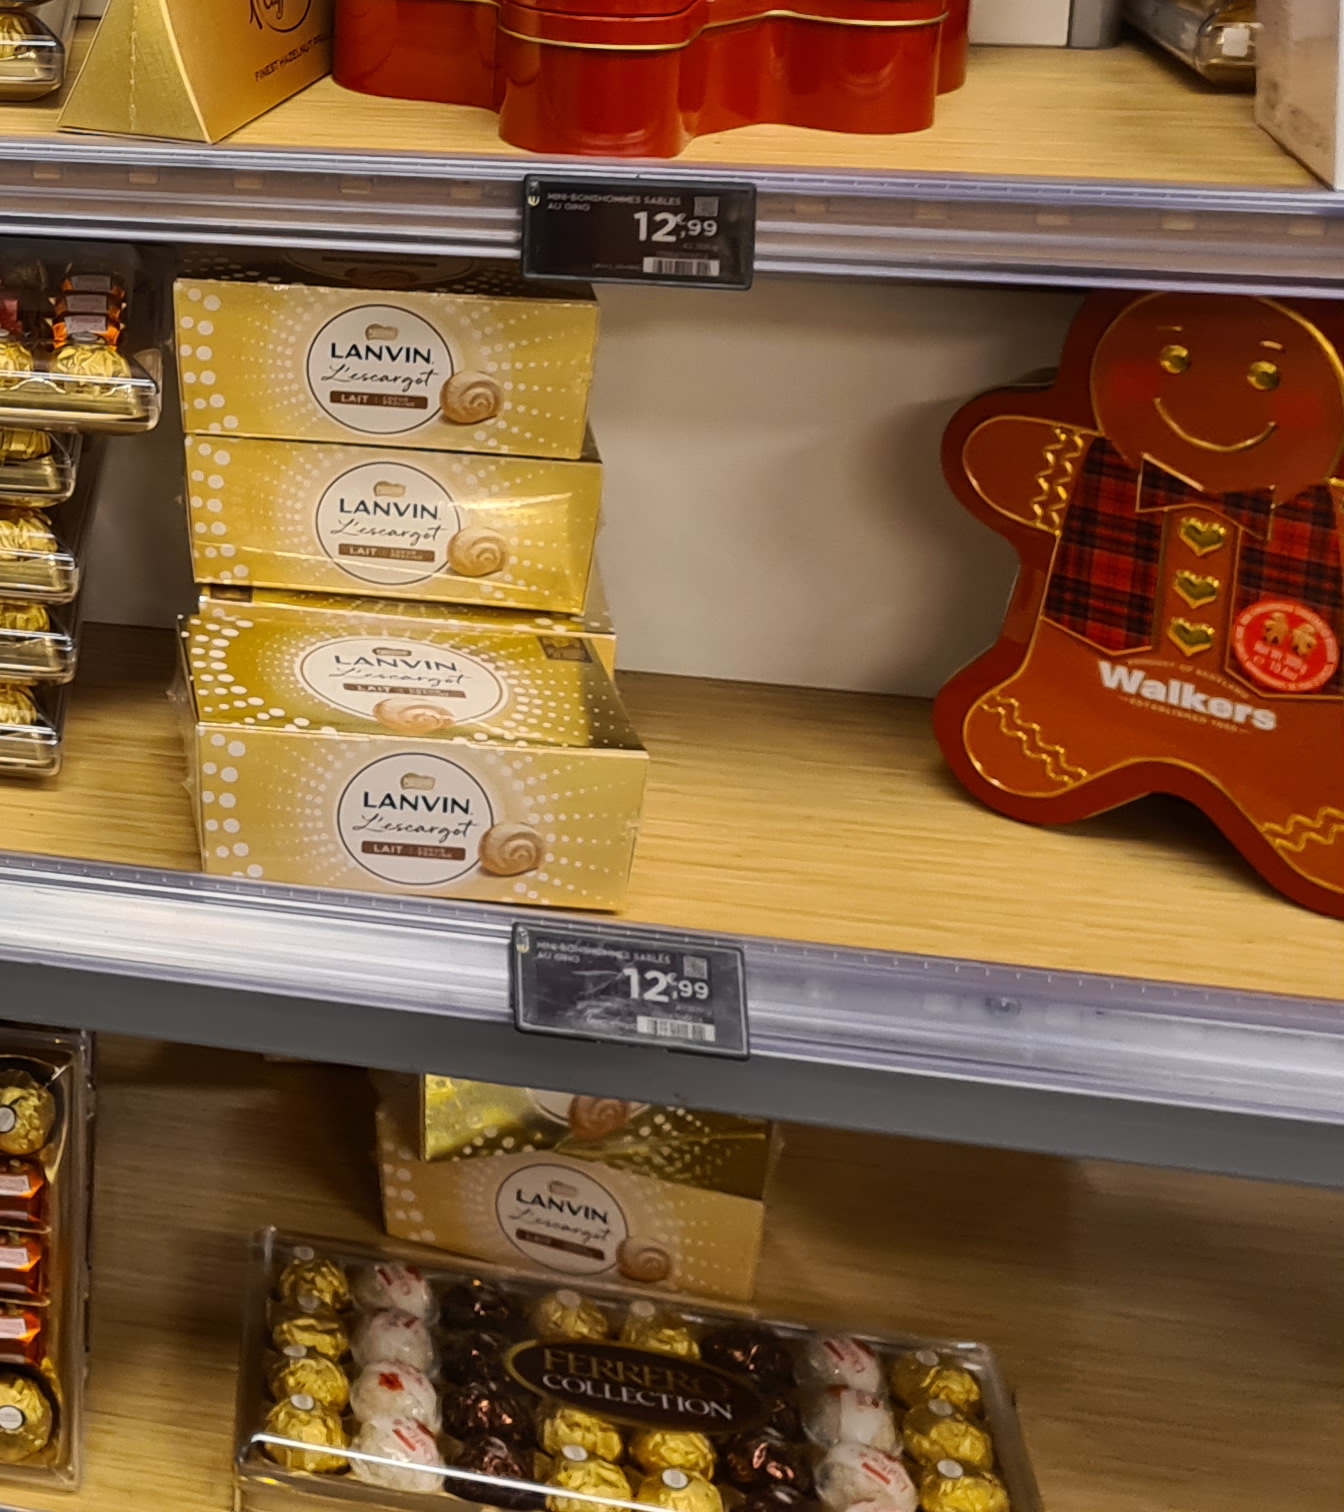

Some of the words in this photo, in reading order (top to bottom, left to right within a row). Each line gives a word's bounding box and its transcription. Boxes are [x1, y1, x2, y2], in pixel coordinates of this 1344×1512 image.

[331, 342, 433, 364] LANVIN
[321, 364, 438, 391] L'escargot
[341, 394, 369, 403] LAIT
[339, 498, 440, 520] LANVIN
[331, 519, 445, 545] L'escargot
[349, 546, 377, 556] LAIT
[334, 655, 462, 672] LANVIN
[1098, 660, 1277, 730] Walkers
[363, 791, 473, 815] LANVIN
[353, 813, 478, 840] L'escargot
[373, 844, 402, 854] LAIT
[516, 1189, 608, 1225] LANVIN
[542, 1374, 733, 1420] COLLECTION
